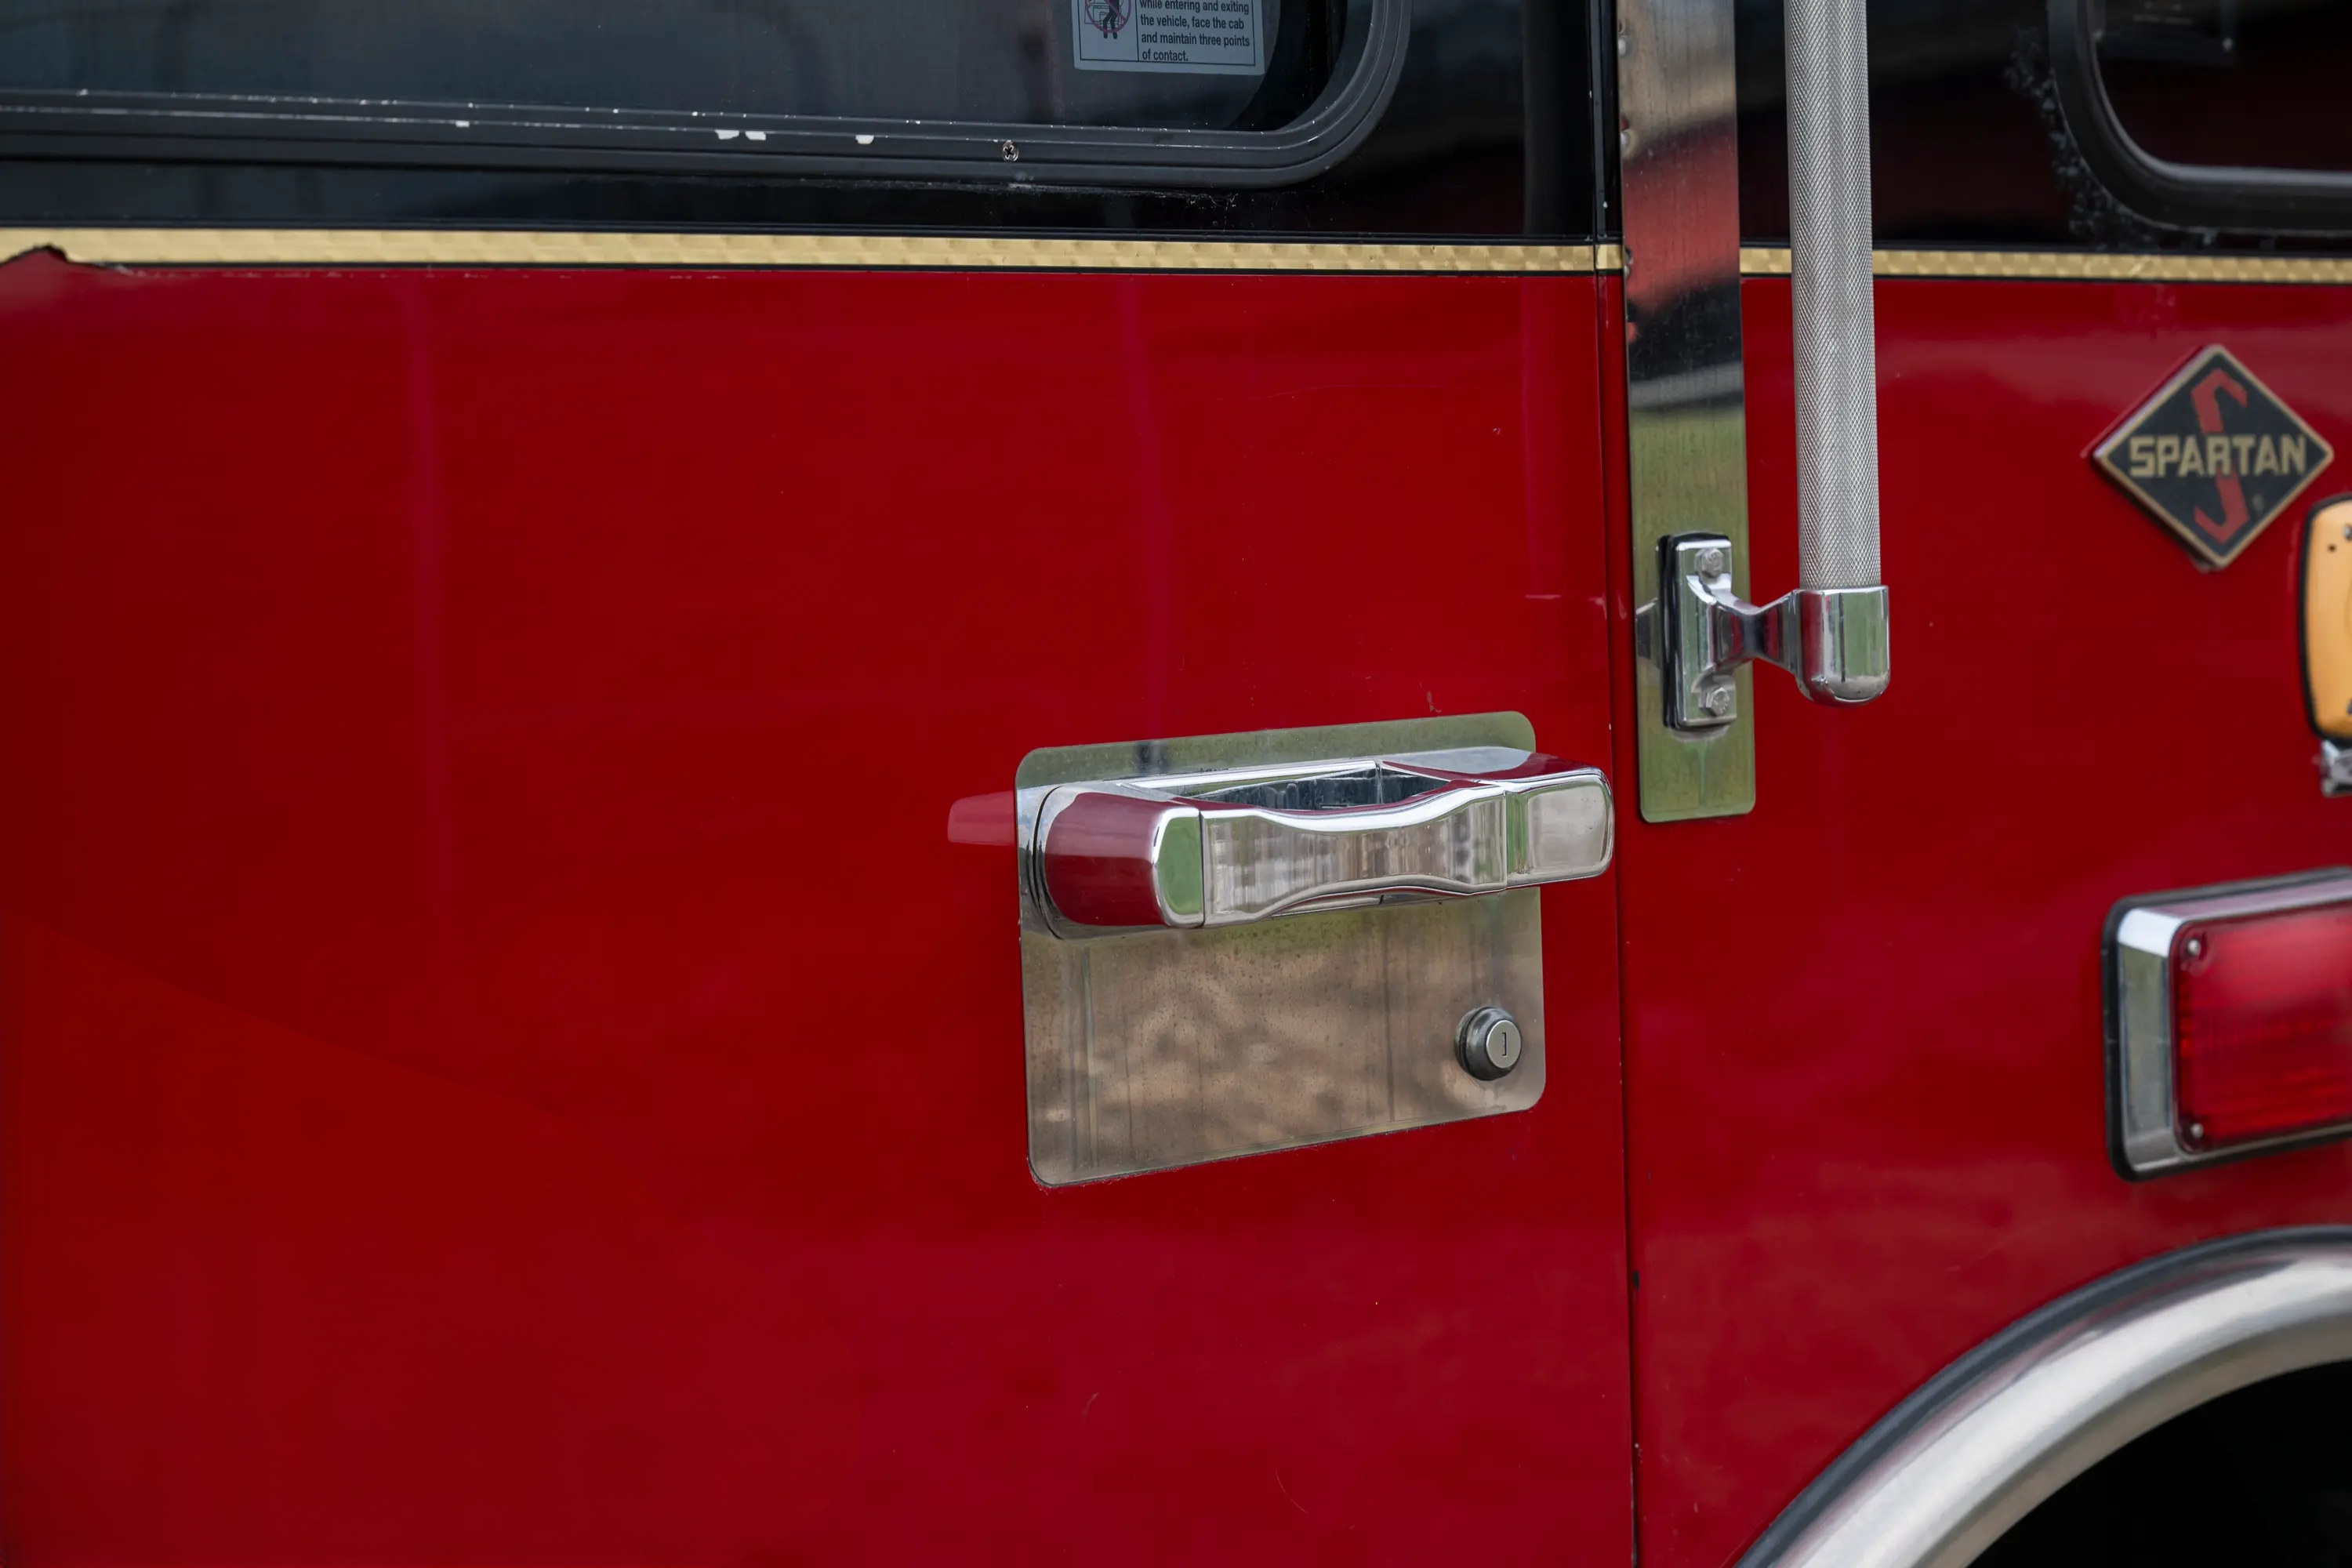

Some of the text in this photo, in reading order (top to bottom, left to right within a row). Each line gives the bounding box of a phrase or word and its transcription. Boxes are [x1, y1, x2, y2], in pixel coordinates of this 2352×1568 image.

[1165, 0, 1200, 13] entering
[1203, 0, 1218, 11] and
[1221, 2, 1249, 15] exiting
[1141, 14, 1244, 30] the vehicle, face the cab
[1142, 31, 1250, 48] and maintain three points
[1142, 49, 1189, 61] of contact.
[2129, 434, 2307, 477] SPARTAN
